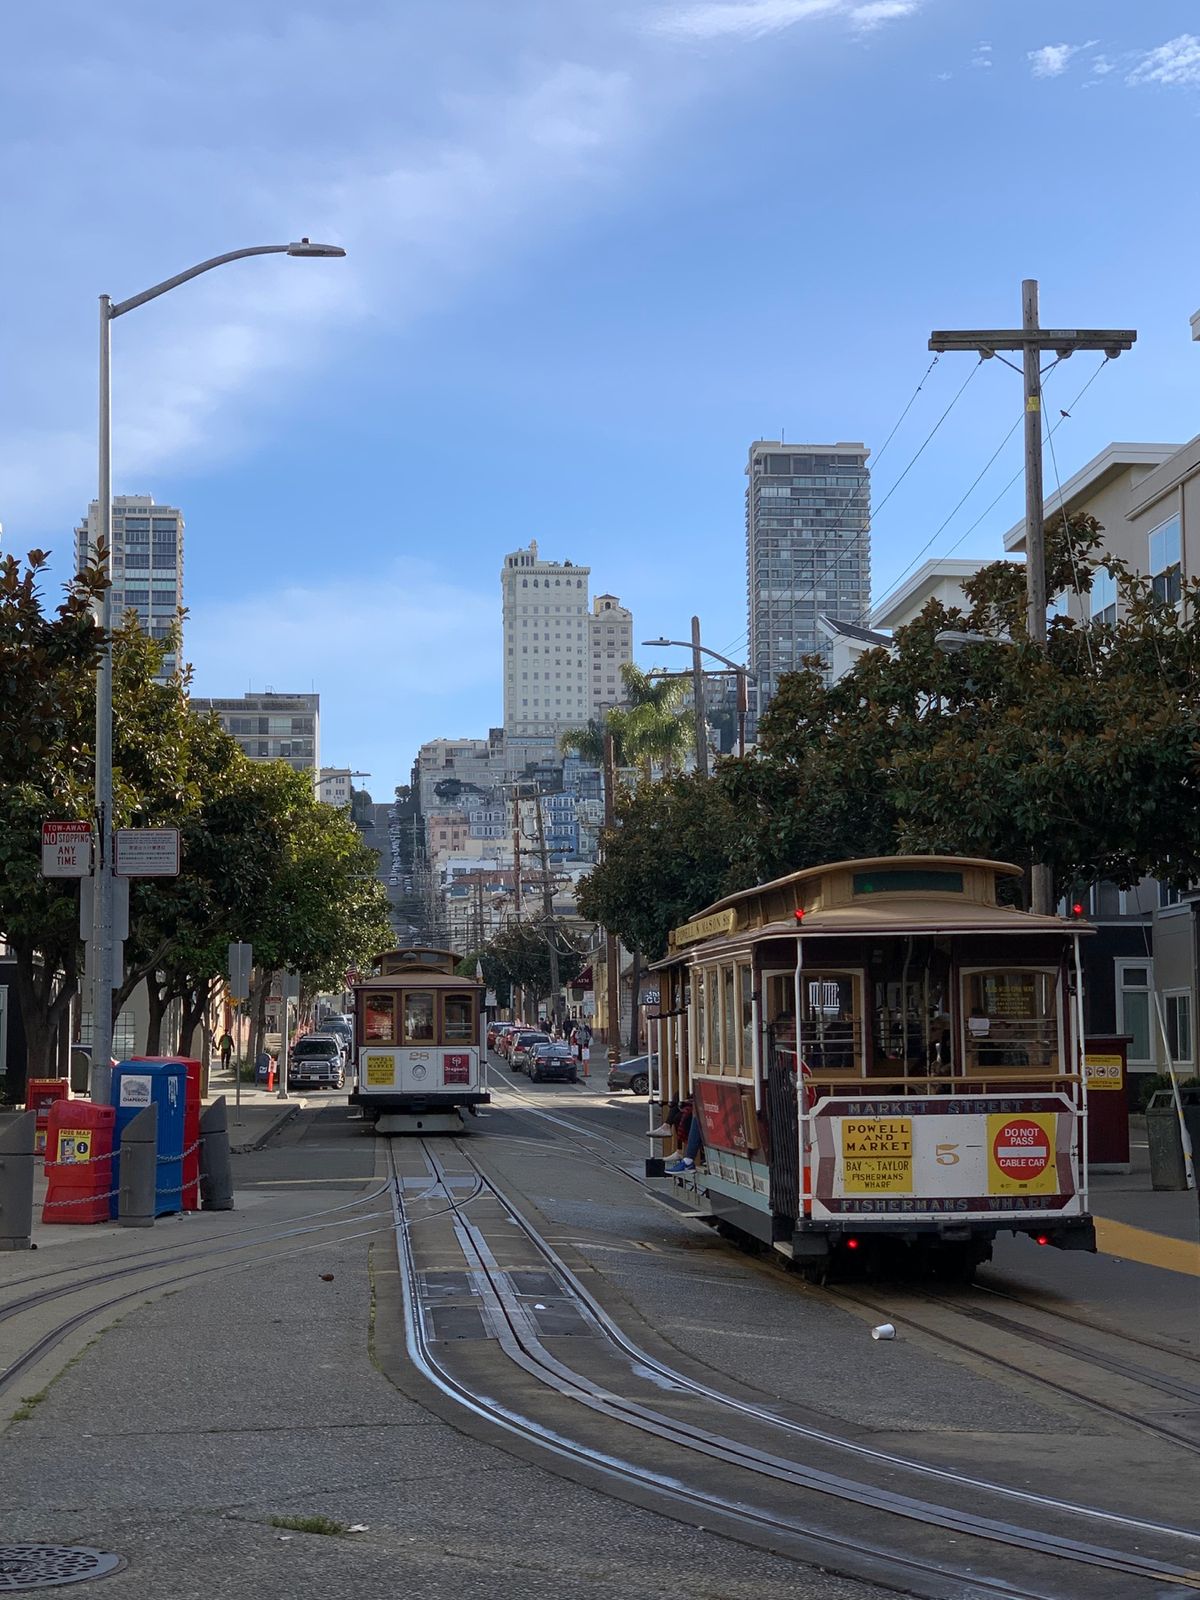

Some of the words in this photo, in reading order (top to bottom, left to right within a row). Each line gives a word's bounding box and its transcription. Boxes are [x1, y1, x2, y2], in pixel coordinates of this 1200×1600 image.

[48, 824, 87, 832] TOW-AWAY
[44, 832, 57, 844] NO
[58, 833, 90, 843] STOPPING
[57, 846, 76, 855] ANY
[57, 856, 77, 866] TIME
[409, 1051, 430, 1061] 28
[848, 1102, 928, 1115] MARKET
[947, 1100, 1024, 1113] STREET
[847, 1124, 909, 1134] POWELL
[1004, 1128, 1019, 1137] DO
[1020, 1127, 1040, 1136] NOT
[1010, 1136, 1034, 1145] PASS
[846, 1141, 910, 1151] MARKET
[935, 1143, 960, 1166] 5
[846, 1161, 862, 1171] BAY
[877, 1160, 909, 1171] TAYLOR
[1000, 1159, 1026, 1168] CABLE
[1028, 1158, 1045, 1167] CAR
[864, 1181, 891, 1189] WHARF
[840, 1199, 969, 1214] FISHERMANS
[988, 1197, 1051, 1210] WHARF
